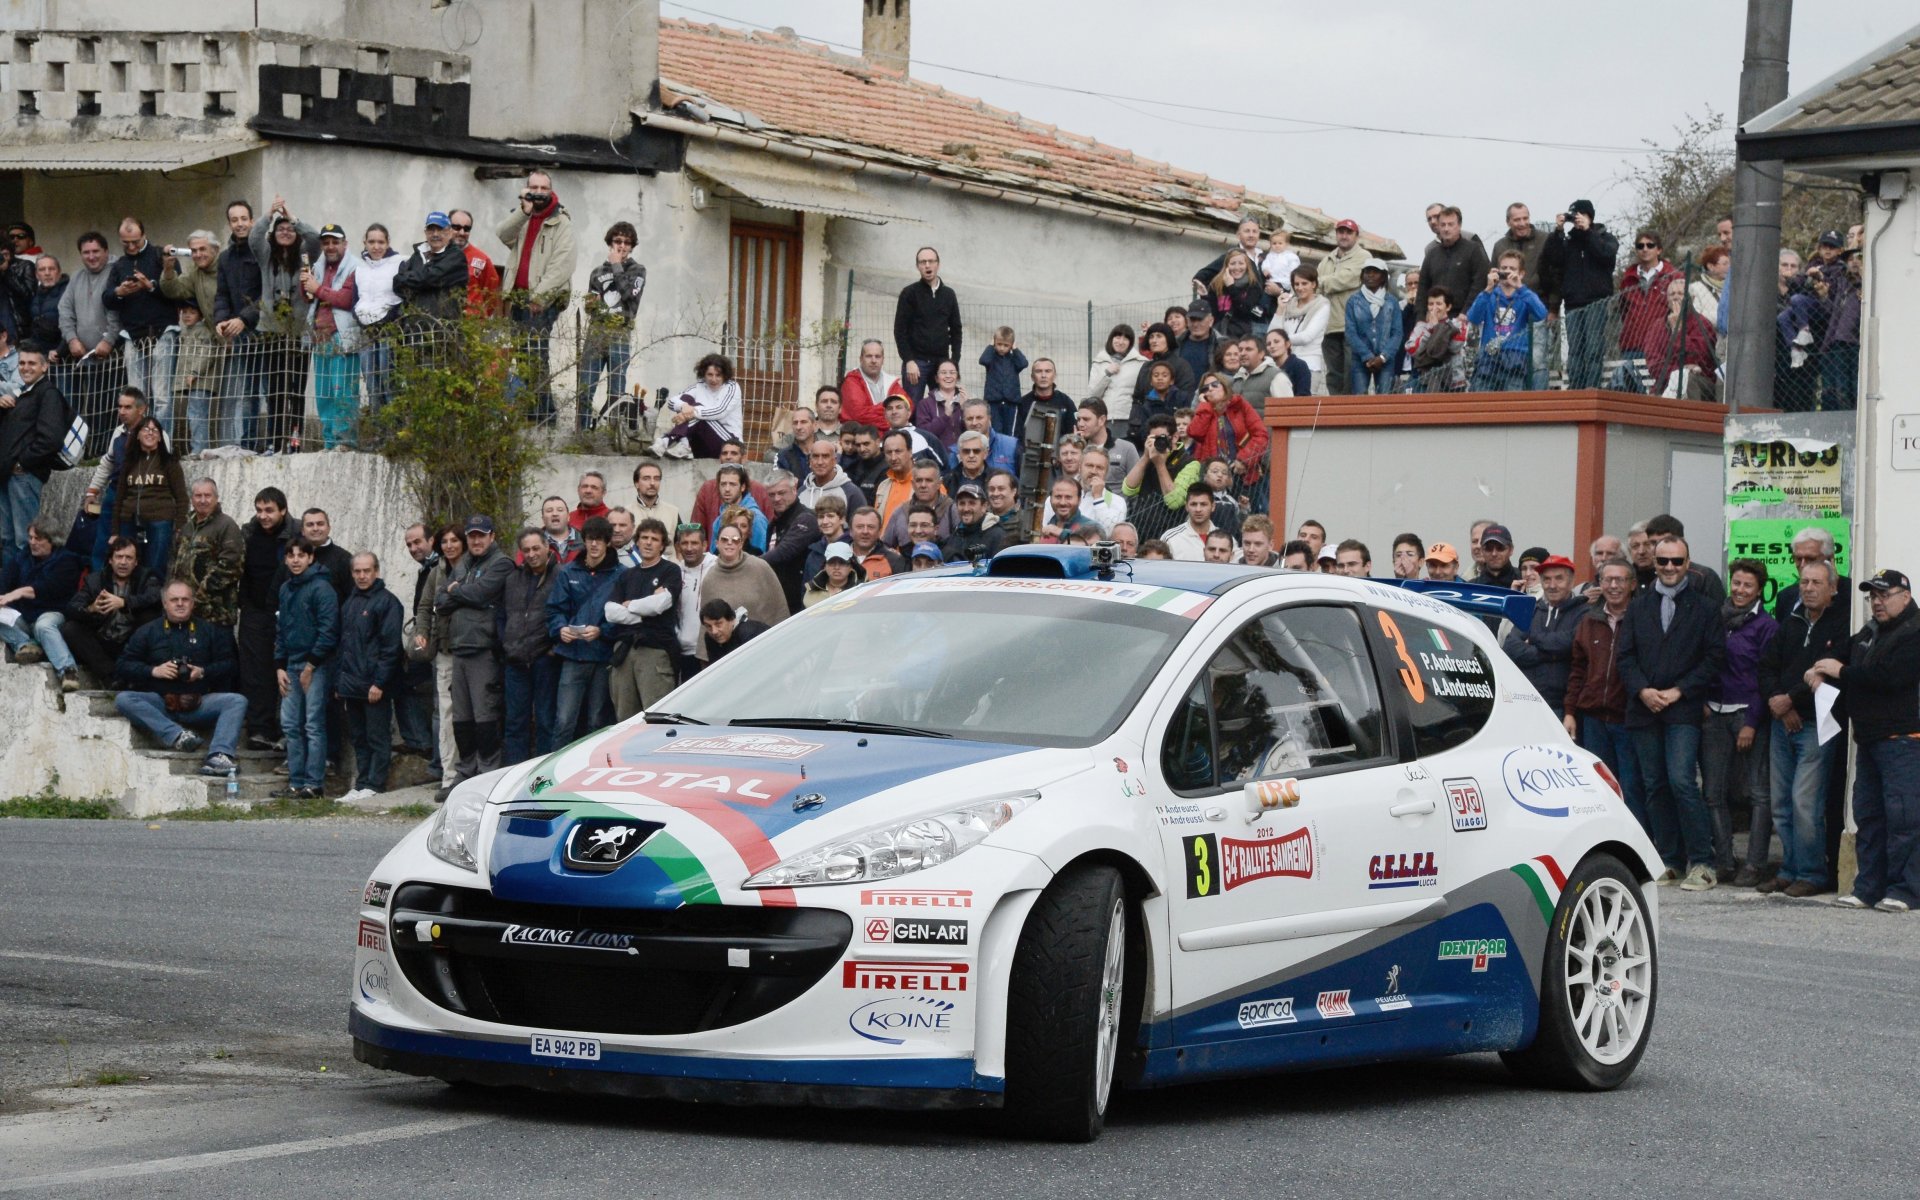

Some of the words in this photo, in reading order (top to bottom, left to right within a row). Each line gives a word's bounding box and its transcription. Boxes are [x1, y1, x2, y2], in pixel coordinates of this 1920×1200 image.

[917, 578, 1114, 595] ircseries.com
[1377, 610, 1425, 704] 3
[580, 765, 772, 800] TOTAL
[1165, 803, 1200, 814] Andreucci
[1170, 814, 1205, 825] Andreussi
[1456, 817, 1485, 828] VIAGGI
[1257, 827, 1274, 838] 2012
[1240, 845, 1271, 878] RALLYE
[1271, 834, 1311, 873] SANREMO
[1194, 836, 1211, 896] 3
[1419, 879, 1437, 887] LUCCA
[860, 889, 973, 908] PIRELLI
[894, 923, 967, 941] GEN-ART
[1440, 939, 1506, 956] IDENTICAR
[843, 960, 970, 992] PIRELLI
[1318, 991, 1350, 1014] FIAMM
[1375, 993, 1407, 1004] PEUGEOT
[1239, 1000, 1292, 1023] sparco
[535, 1036, 552, 1055] EA
[554, 1039, 576, 1057] 942
[579, 1041, 597, 1058] PB
